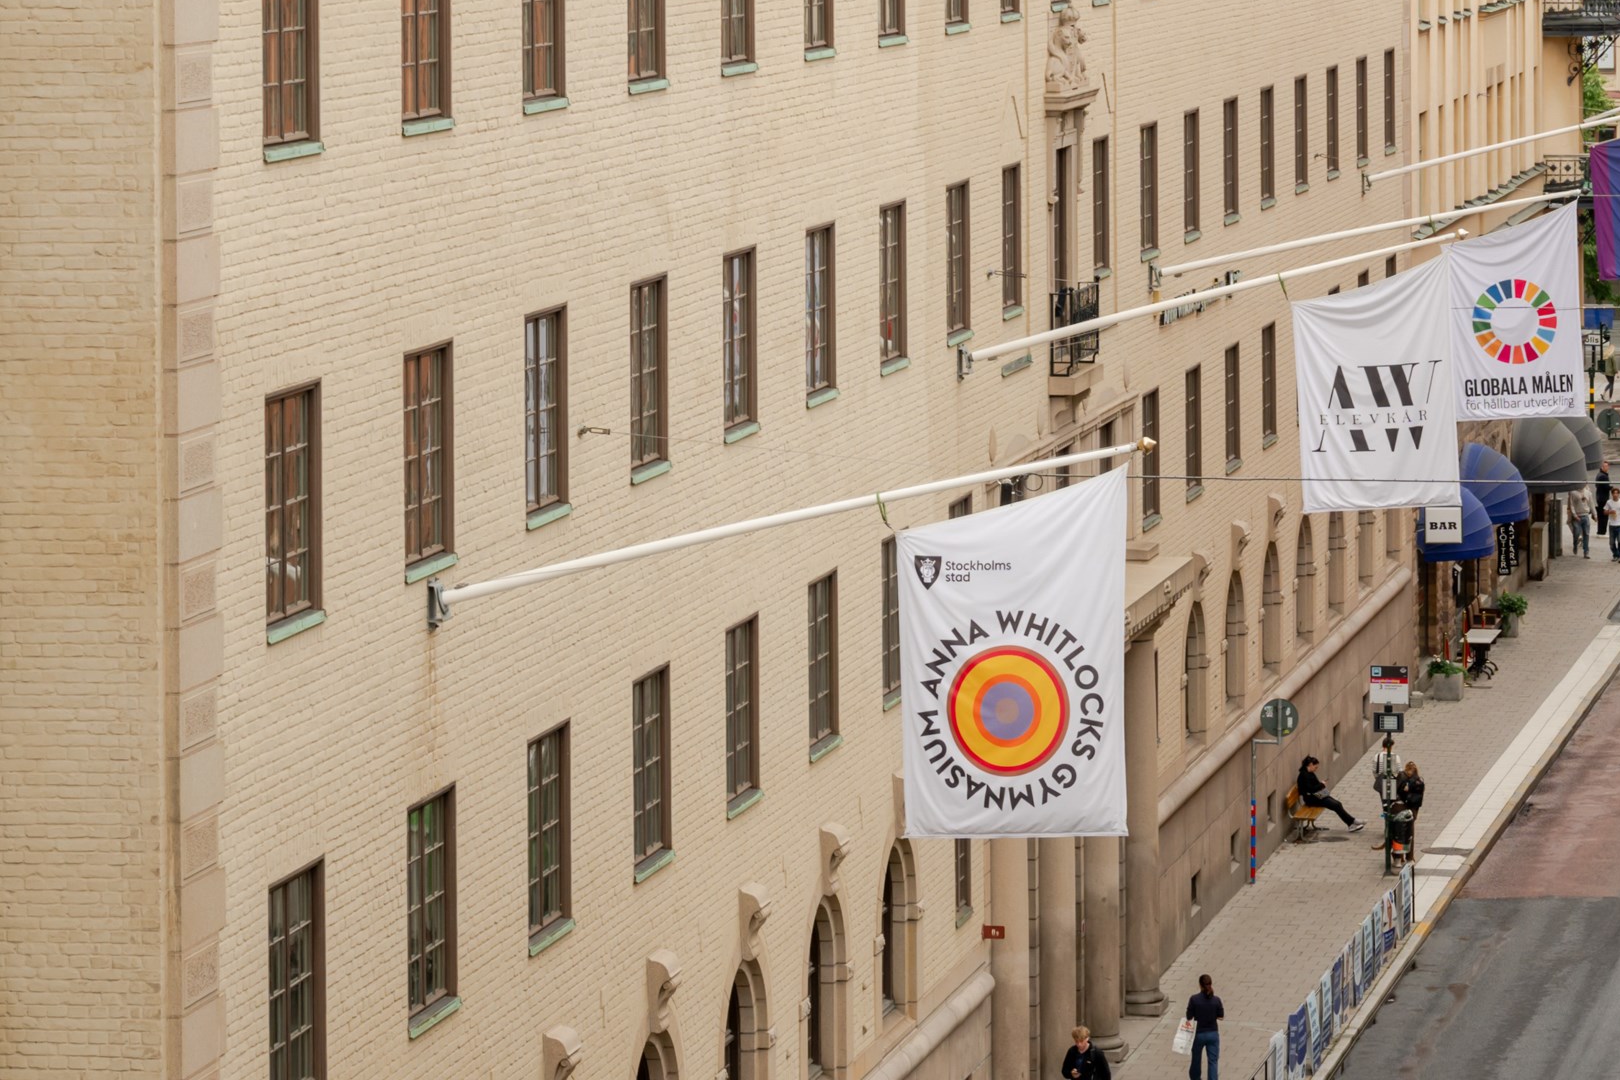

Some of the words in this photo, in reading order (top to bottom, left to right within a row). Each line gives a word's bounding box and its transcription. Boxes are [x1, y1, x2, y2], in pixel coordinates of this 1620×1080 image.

[1465, 376, 1528, 397] GLOBALA
[1532, 371, 1573, 394] MÅLEN
[1466, 398, 1481, 410] för
[1483, 396, 1520, 409] hållbar
[1523, 395, 1575, 408] utveckling
[1320, 409, 1428, 426] ELEVKÅR
[1429, 522, 1457, 530] BAR
[945, 560, 1012, 571] Stockholms
[945, 572, 971, 582] stad
[920, 618, 989, 700] ANNA
[996, 610, 1105, 761] WHITLOCKS
[917, 709, 1077, 811] GYMNASIUM
